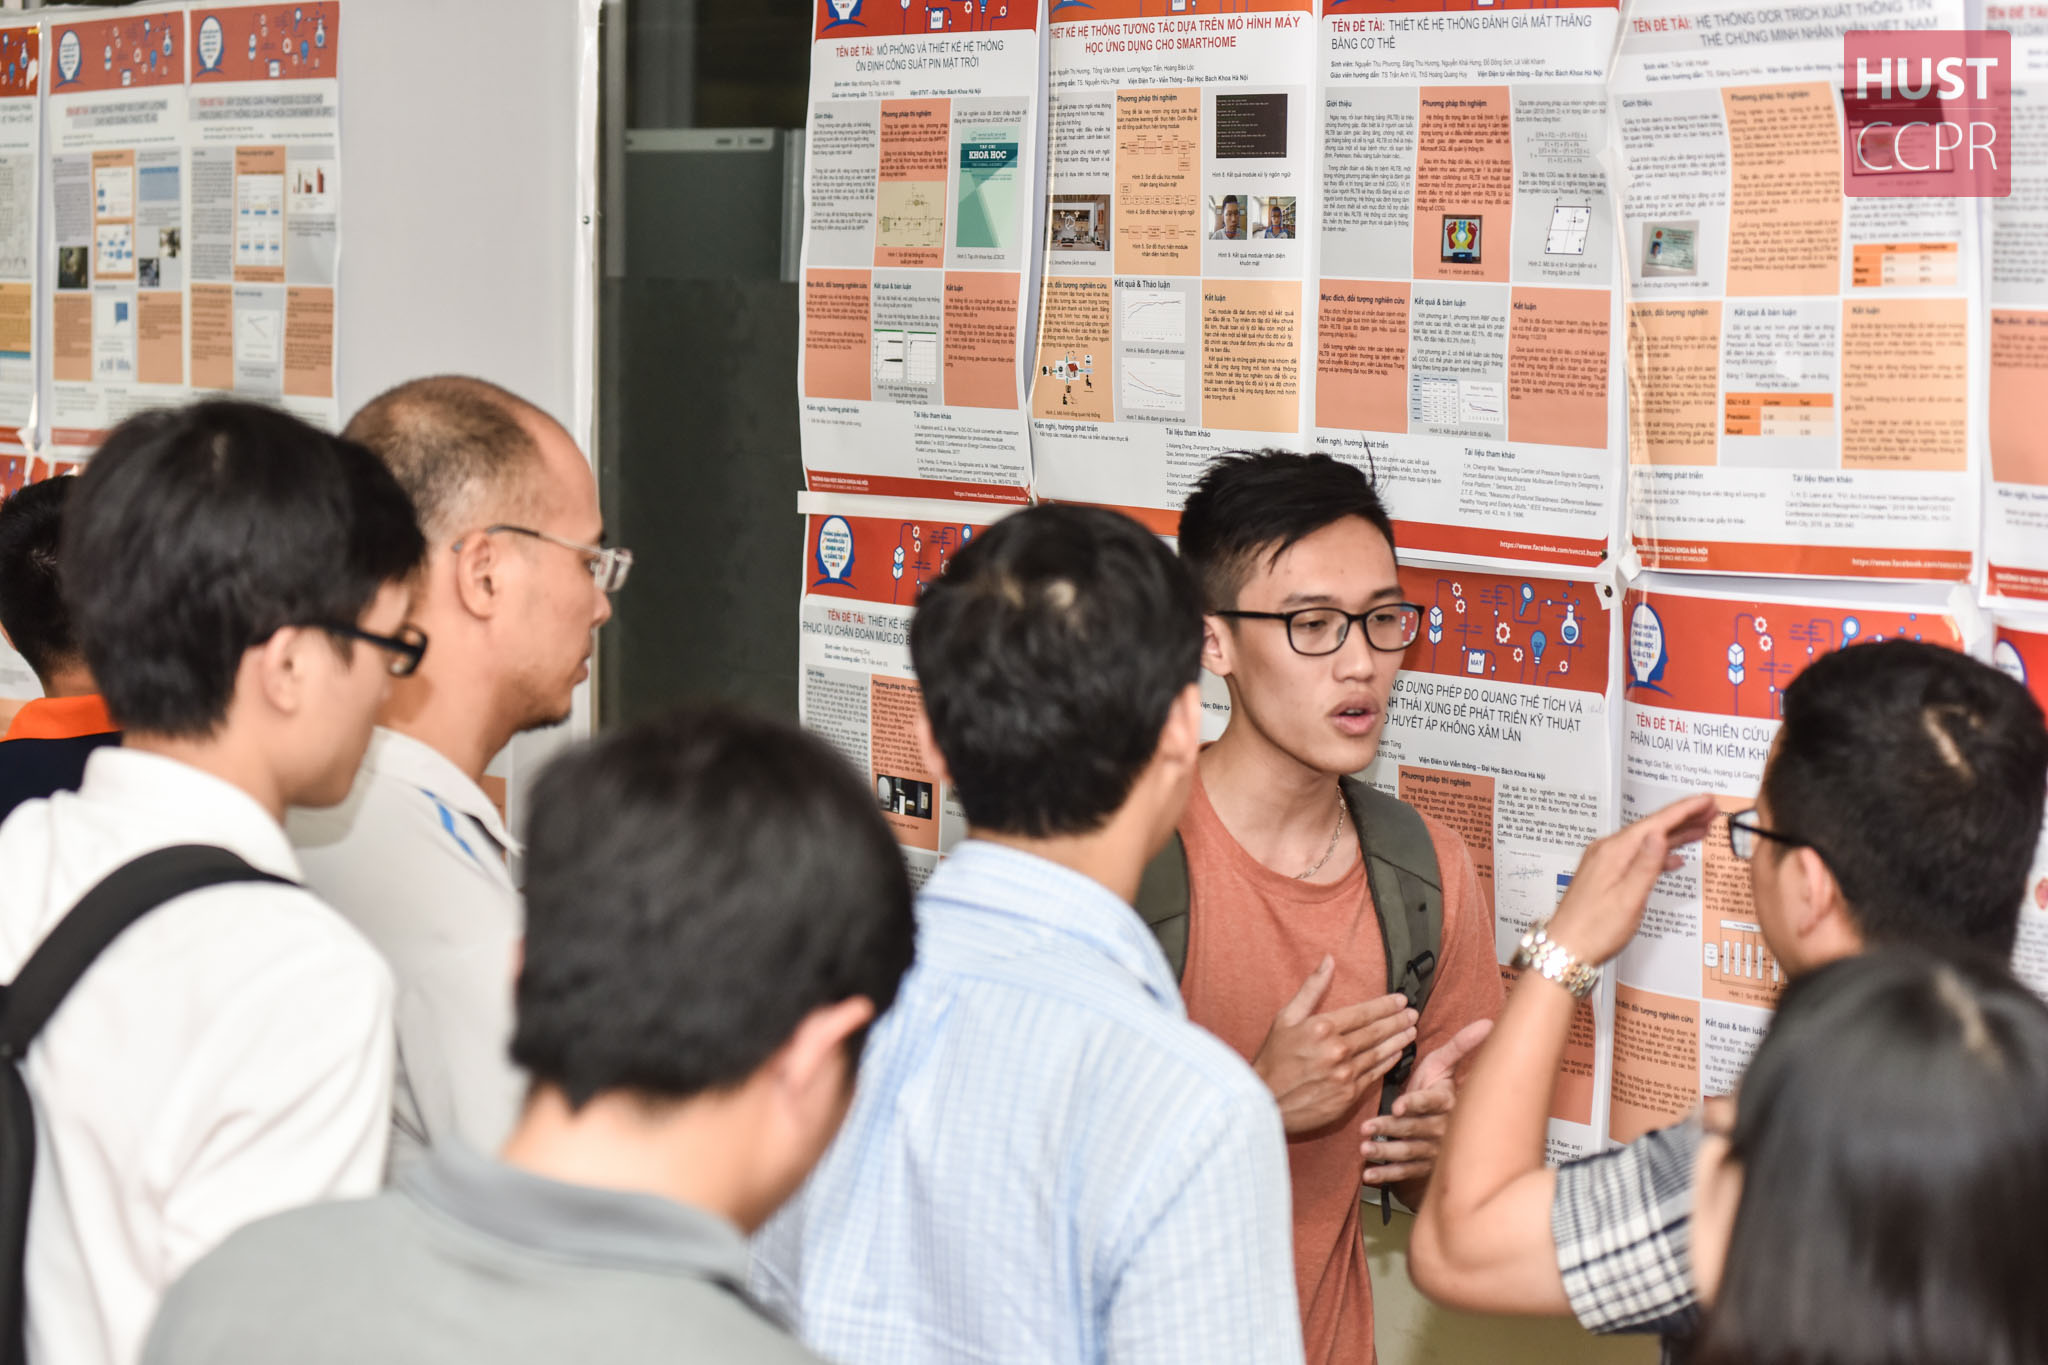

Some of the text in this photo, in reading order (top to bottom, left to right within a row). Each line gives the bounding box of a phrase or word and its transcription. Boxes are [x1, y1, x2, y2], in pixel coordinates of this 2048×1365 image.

[1065, 25, 1075, 37] KẾ
[1077, 25, 1088, 37] HỆ
[1091, 23, 1120, 36] THỐNG
[1122, 22, 1155, 34] TƯƠNG
[1157, 21, 1174, 33] TÁC
[1177, 20, 1196, 34] DỰA
[1198, 18, 1224, 31] TRÊN
[1227, 16, 1243, 30] MÔ
[1246, 16, 1271, 29] HÌNH
[1274, 15, 1300, 28] MÁY
[1331, 14, 1591, 32] TÊN ĐỀ TÀI: THIẾT KẾ HỆ THỐNG ĐÁNH GIÁ MẤT THĂNG
[1632, 16, 1651, 33] TÊN
[1653, 16, 1668, 32] ĐỀ
[1669, 14, 1691, 30] TÀI:
[1695, 13, 1711, 29] HỆ
[1713, 10, 1755, 26] THỐNG
[1757, 8, 1780, 23] OCR
[1784, 6, 1820, 21] TRÍCH
[1822, 2, 1852, 18] XUẤT
[836, 45, 848, 57] TÊN
[861, 43, 875, 55] TÀI:
[876, 42, 888, 55] MÔ
[889, 43, 915, 55] PHỎNG
[916, 43, 926, 53] VÀ
[928, 41, 949, 53] THIẾT
[950, 40, 961, 52] KẾ
[962, 40, 974, 53] HỆ
[976, 39, 1003, 51] THỐNG
[1085, 35, 1236, 53] HỌC ỨNG DỤNG CHO SMARTHOME
[1331, 34, 1395, 49] BẰNG CƠ THỂ
[968, 150, 1006, 159] KHOA HỌC
[1114, 279, 1170, 288] Kết quả & Thảo luận
[827, 608, 840, 621] TÊN
[841, 610, 851, 622] ĐỀ
[852, 611, 864, 624] TÀI:
[868, 614, 887, 628] THIẾT
[888, 615, 898, 629] KẾ
[1392, 678, 1582, 713] NG DỤNG PHÉP ĐO QUANG THỂ TÍCH VÀ
[1388, 696, 1579, 731] NH THÁI XUNG ĐỂ PHÁT TRIỂN KỸ THUẬT
[1384, 712, 1521, 742] O HUYẾT ÁP KHÔNG XÂM LẤN
[1636, 712, 1651, 728] TÊN
[1653, 715, 1666, 731] ĐỀ
[1668, 717, 1688, 733] TÀI:
[1693, 722, 1738, 739] NGHIÊN
[1630, 732, 1649, 746] PHÂN
[1651, 735, 1673, 750] LOẠI
[1675, 736, 1690, 752] VÀ
[1693, 740, 1712, 754] TÌM
[1715, 742, 1745, 758] KIẾM
